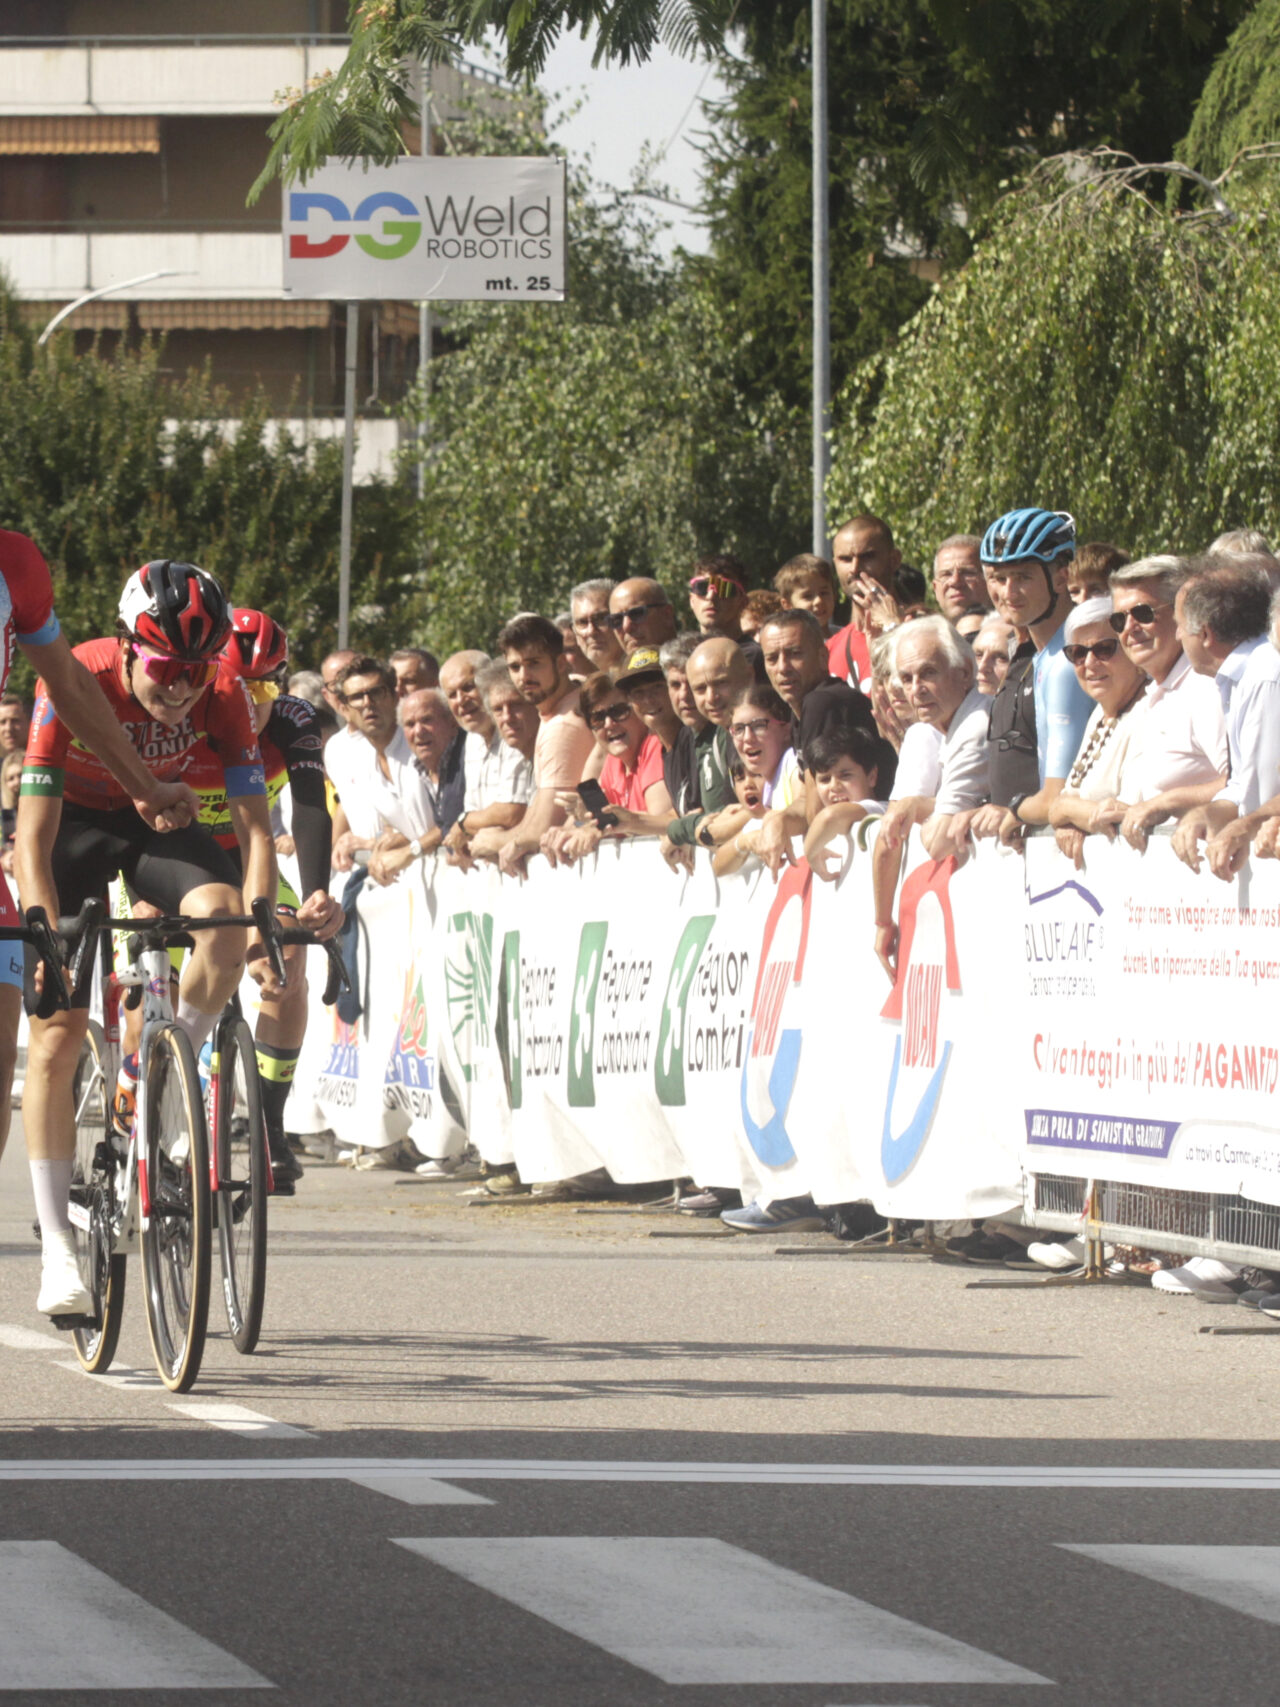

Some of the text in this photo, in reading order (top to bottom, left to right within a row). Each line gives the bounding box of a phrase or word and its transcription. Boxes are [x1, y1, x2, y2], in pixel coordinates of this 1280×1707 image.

[289, 191, 423, 260] DG
[425, 195, 551, 237] Weld
[426, 238, 552, 259] ROBOTICS
[485, 276, 551, 291] mt. 25
[1150, 947, 1160, 974] la
[599, 948, 653, 1018] Regione
[1075, 1118, 1088, 1142] DI
